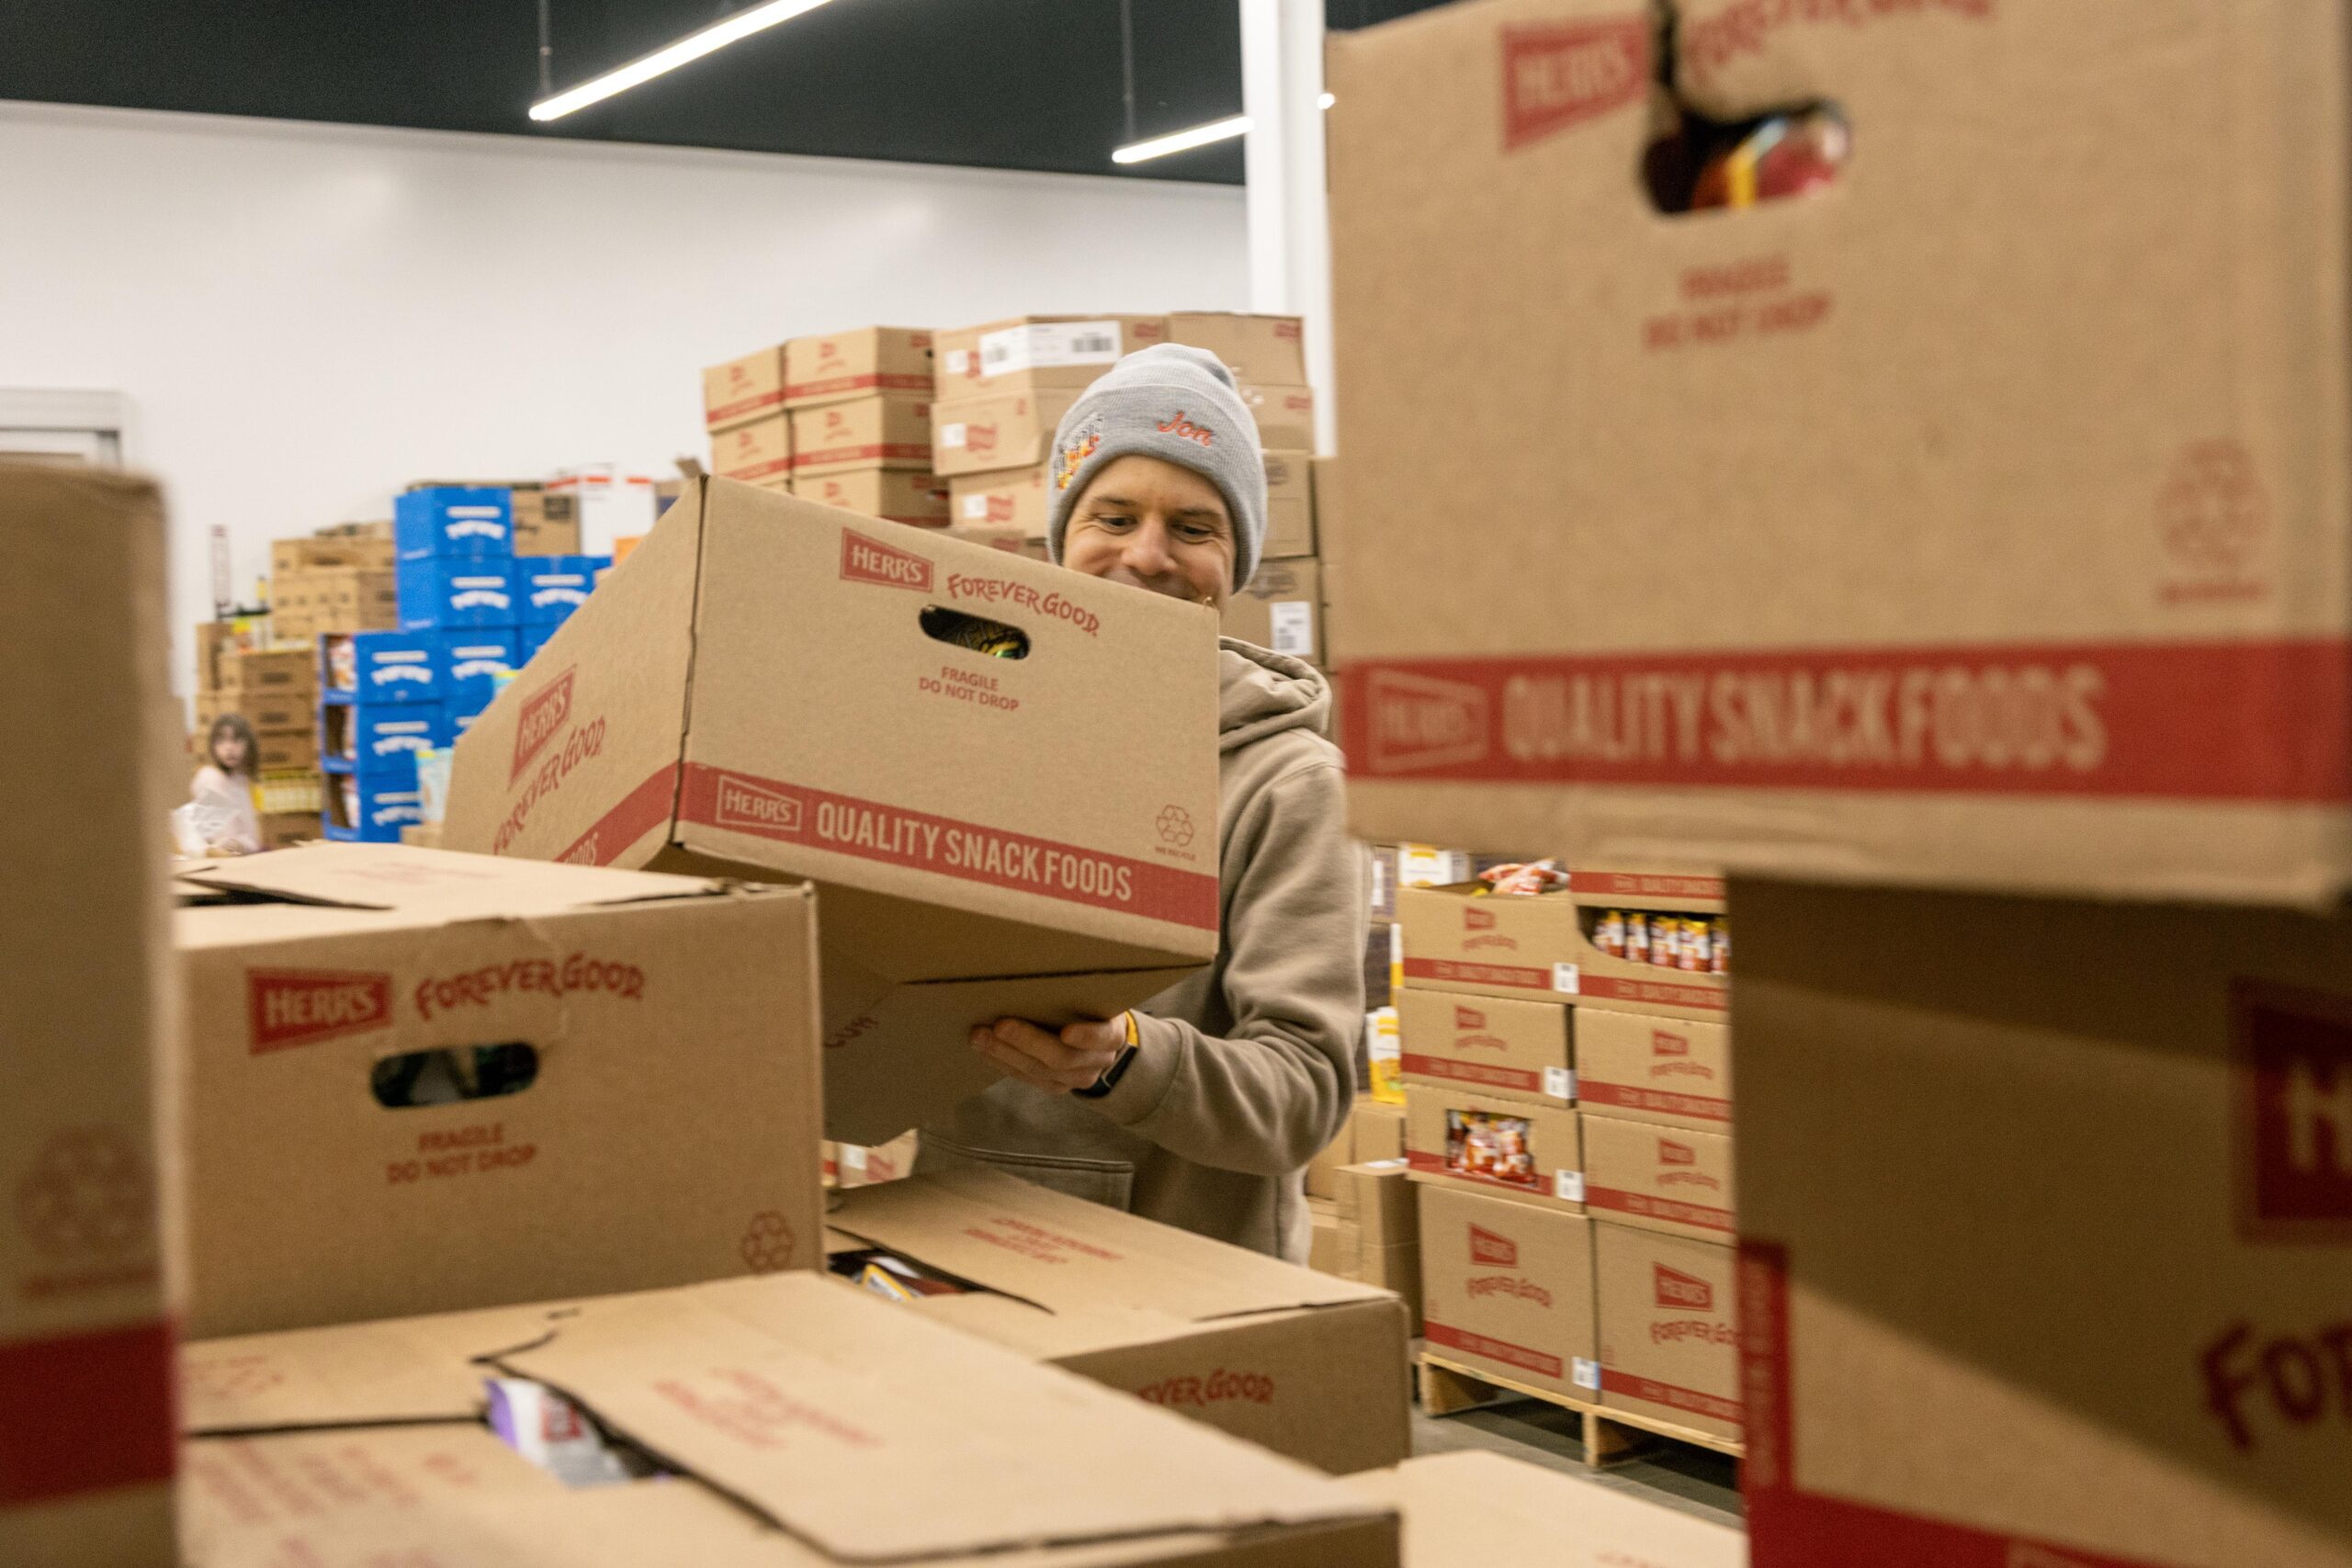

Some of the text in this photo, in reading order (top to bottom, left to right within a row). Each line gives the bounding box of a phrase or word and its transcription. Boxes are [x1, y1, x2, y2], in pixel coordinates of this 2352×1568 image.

[1156, 411, 1211, 446] Jon
[851, 544, 923, 583] HERR'S
[946, 572, 1042, 615] FOREVER
[919, 676, 1019, 713] DO NOT DROP
[941, 666, 1000, 692] FRAGILE
[1503, 672, 1707, 762] QUALITY
[1710, 671, 1898, 767] SNACK
[1898, 662, 2108, 773] FOODS
[724, 788, 1133, 902] HERR'S QUALITY SNACK FOODS
[414, 958, 563, 1021] FOREVER
[418, 1122, 505, 1154] FRAGILE
[386, 1144, 537, 1186] DO NOT DROP
